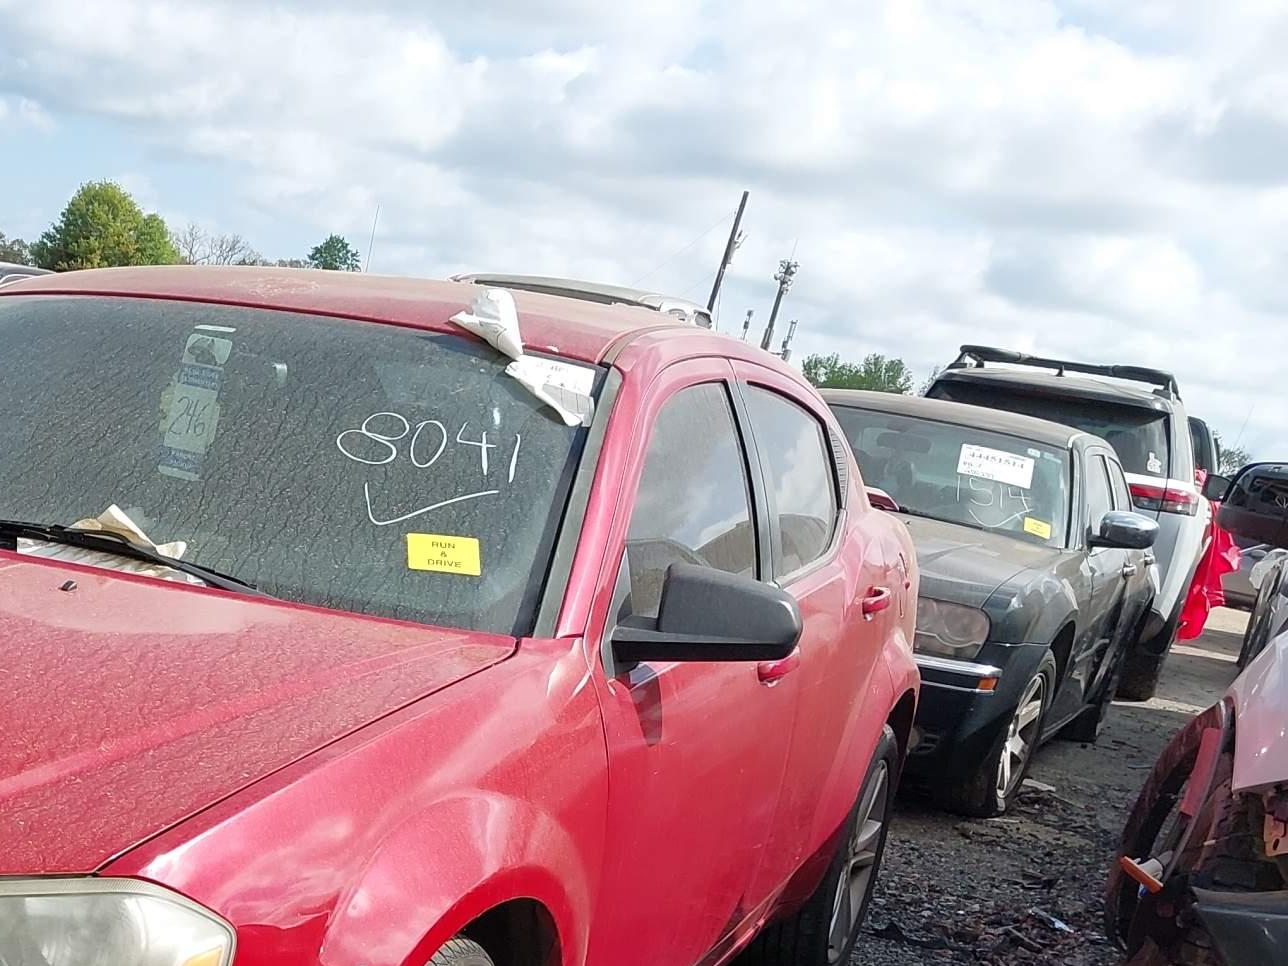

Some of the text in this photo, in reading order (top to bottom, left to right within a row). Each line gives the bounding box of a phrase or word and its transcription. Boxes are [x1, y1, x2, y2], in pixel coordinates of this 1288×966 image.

[336, 412, 521, 483] 8041
[956, 474, 1032, 513] 1514
[431, 541, 456, 549] RUN
[427, 558, 463, 568] DRIVE
